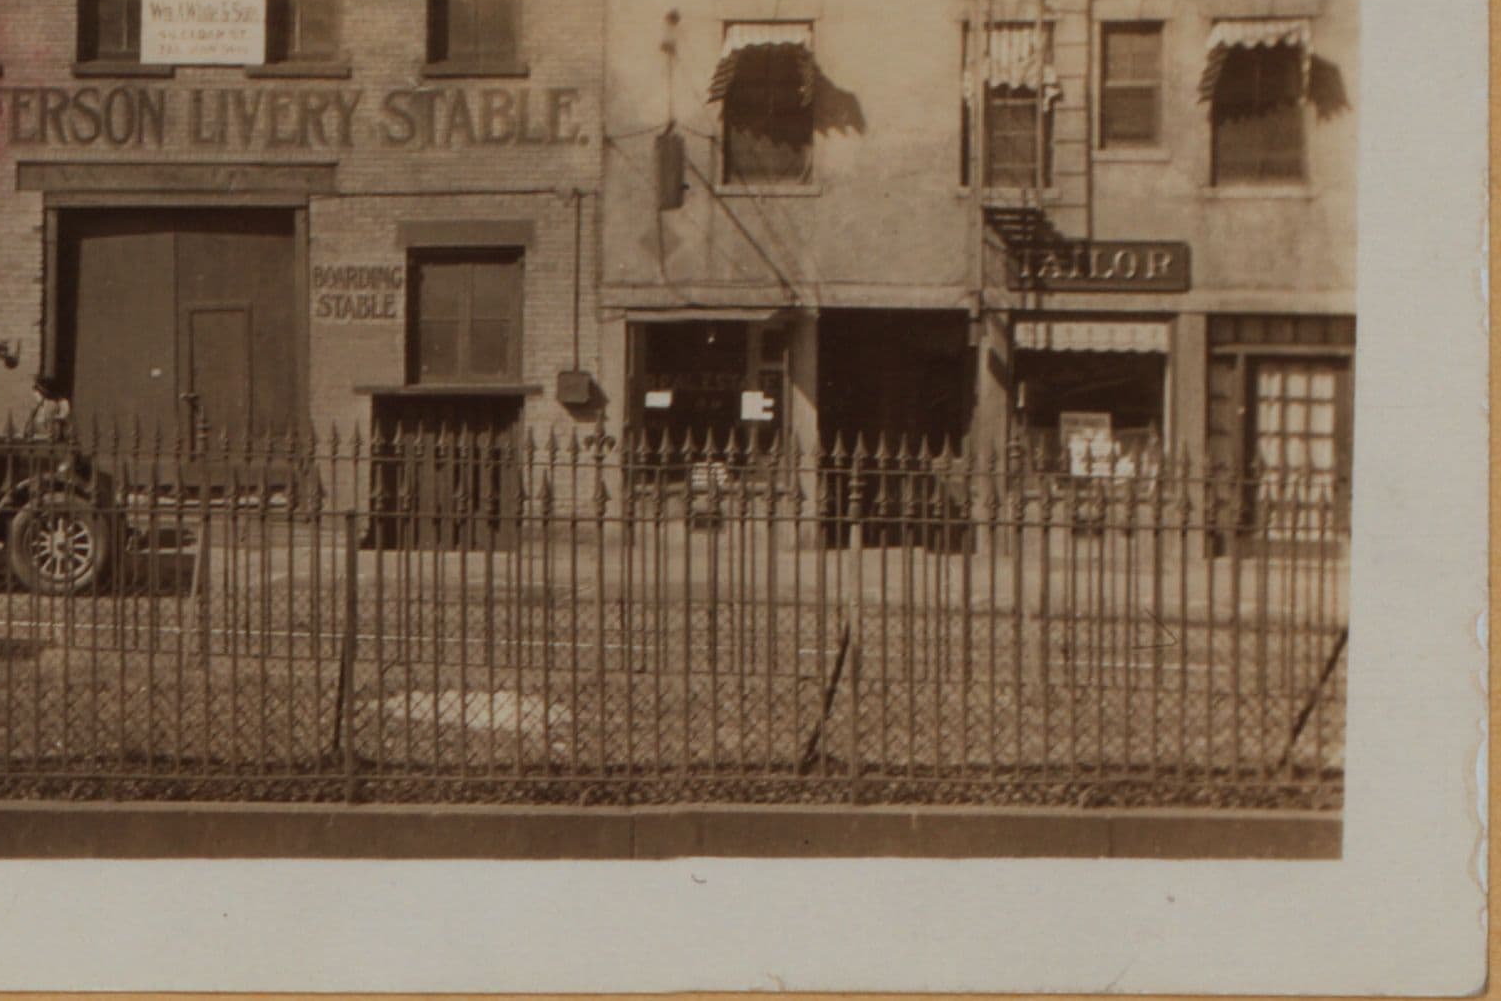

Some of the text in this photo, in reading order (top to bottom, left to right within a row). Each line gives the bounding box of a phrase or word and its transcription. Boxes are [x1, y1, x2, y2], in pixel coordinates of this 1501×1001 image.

[193, 88, 363, 148] LIVERY
[378, 87, 591, 148] STABLE.
[312, 264, 402, 290] BOARDING
[1016, 246, 1173, 279] TAILOR
[316, 293, 398, 319] STABLE
